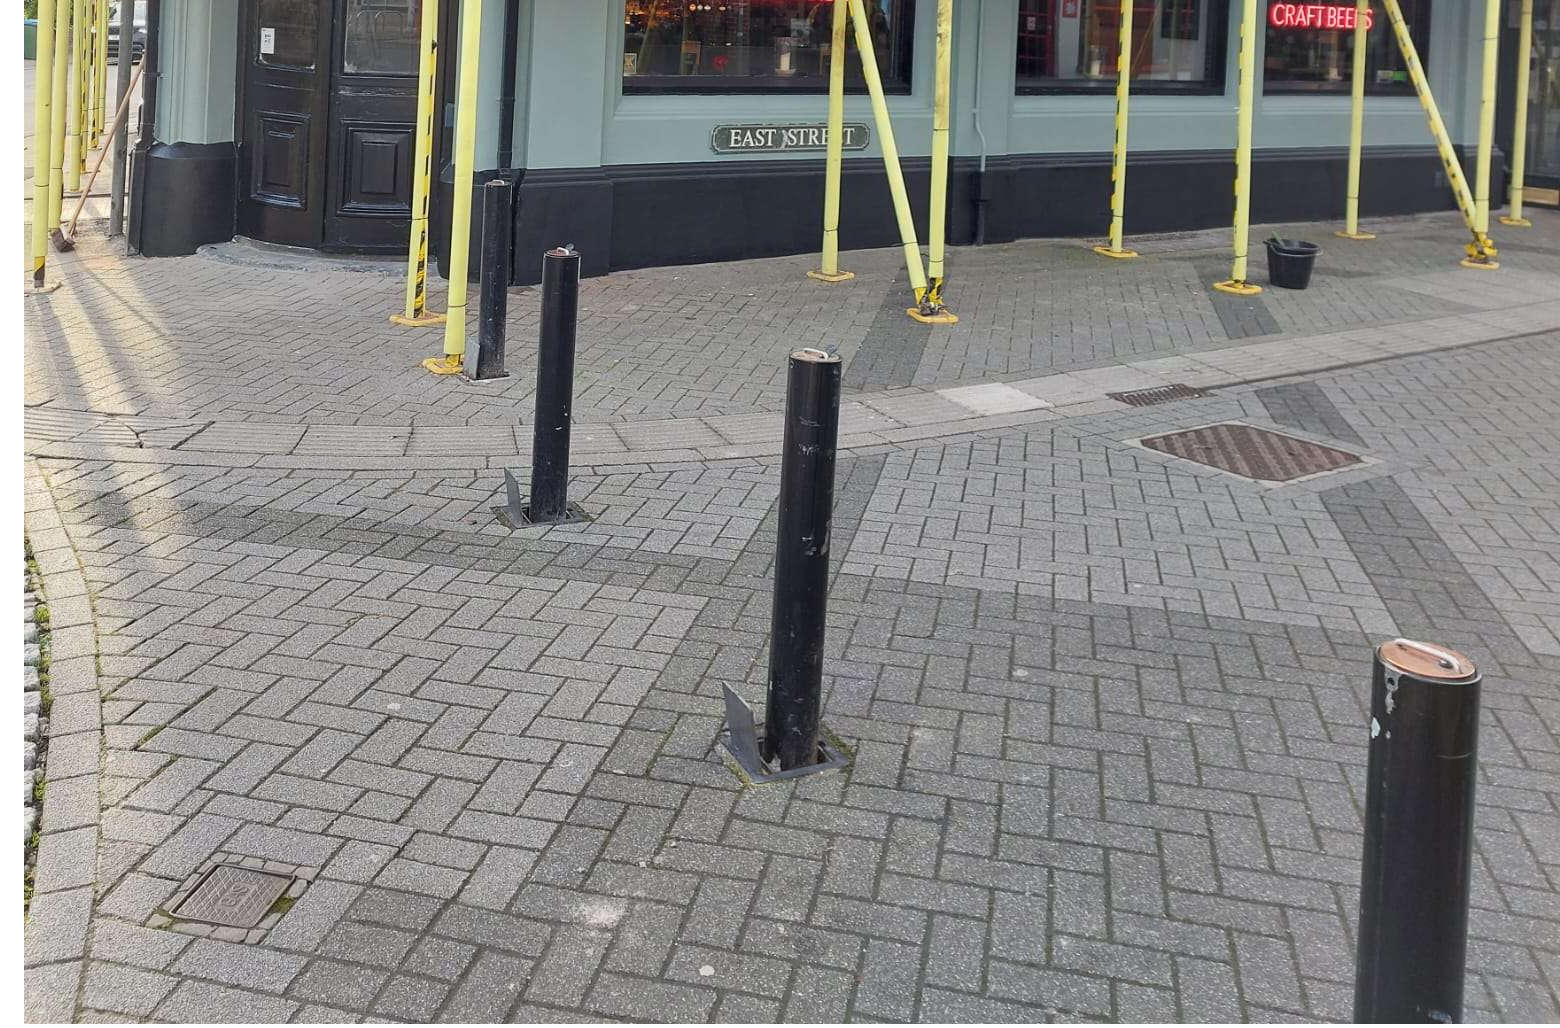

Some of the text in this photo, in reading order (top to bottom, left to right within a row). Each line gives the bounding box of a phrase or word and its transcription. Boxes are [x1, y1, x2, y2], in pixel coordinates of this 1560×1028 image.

[1273, 4, 1325, 28] CRAFT
[729, 127, 855, 147] EAST STRET
